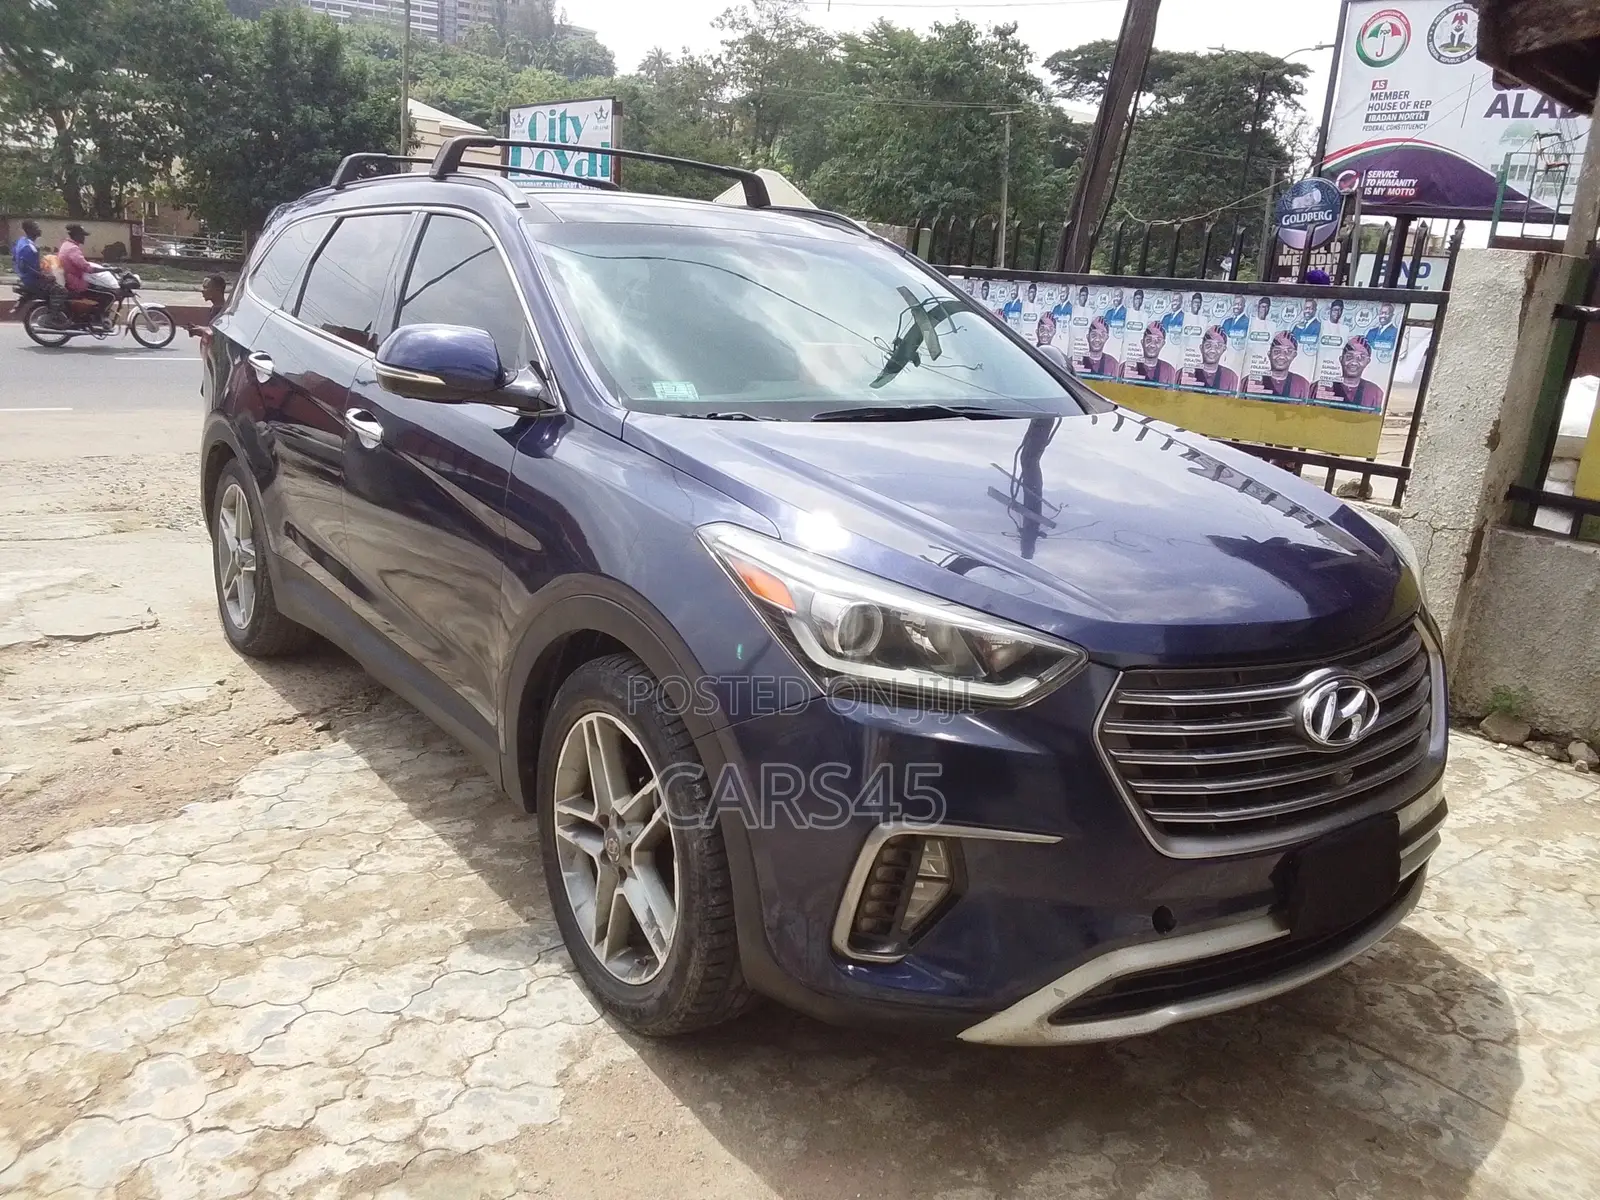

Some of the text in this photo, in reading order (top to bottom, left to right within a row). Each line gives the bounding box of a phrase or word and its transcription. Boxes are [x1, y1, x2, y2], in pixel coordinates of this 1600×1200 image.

[1374, 81, 1386, 89] AS
[1370, 90, 1410, 101] MEMBER
[1367, 99, 1432, 111] HOUSE OF REP
[1368, 112, 1426, 122] IBADAN NORTH
[528, 108, 589, 144] City
[1367, 170, 1399, 178] SERVICE
[1376, 179, 1418, 187] HUMANITY
[1364, 187, 1415, 196] IS MY MOTTO
[1281, 209, 1333, 226] GOLDBERG
